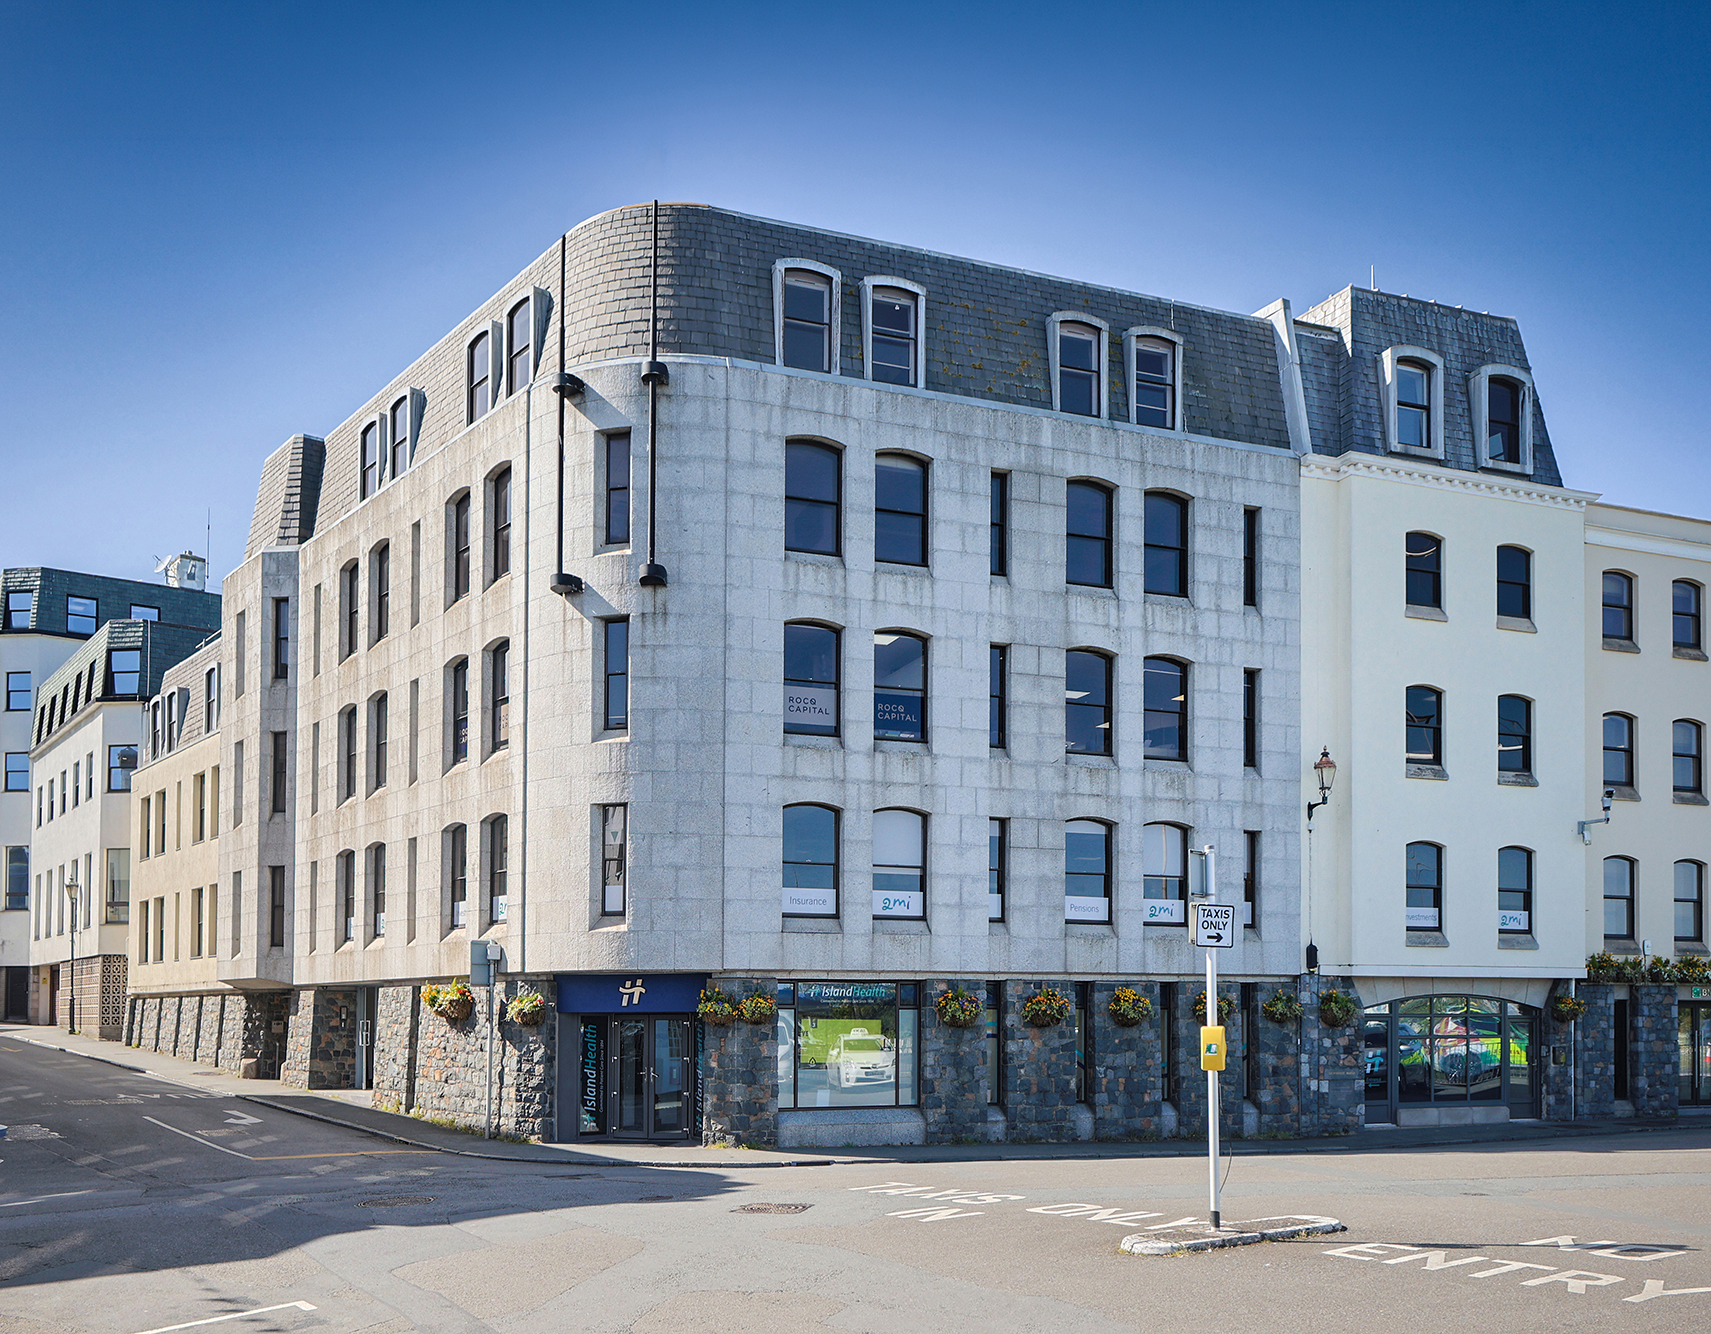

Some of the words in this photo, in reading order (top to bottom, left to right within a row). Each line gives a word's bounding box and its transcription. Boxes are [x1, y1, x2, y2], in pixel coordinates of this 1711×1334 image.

[788, 705, 830, 715] CAPITAL
[877, 712, 917, 722] CAPITAL
[789, 896, 827, 906] Insurance
[1069, 904, 1100, 913] Pensions
[1201, 908, 1230, 919] TAXIS
[1201, 920, 1228, 931] ONLY
[848, 1181, 1026, 1205] TAXIS
[1026, 1203, 1210, 1230] ONLY
[885, 1206, 985, 1223] IN
[1518, 1235, 1687, 1262] NO
[1321, 1243, 1711, 1303] ENTRY
